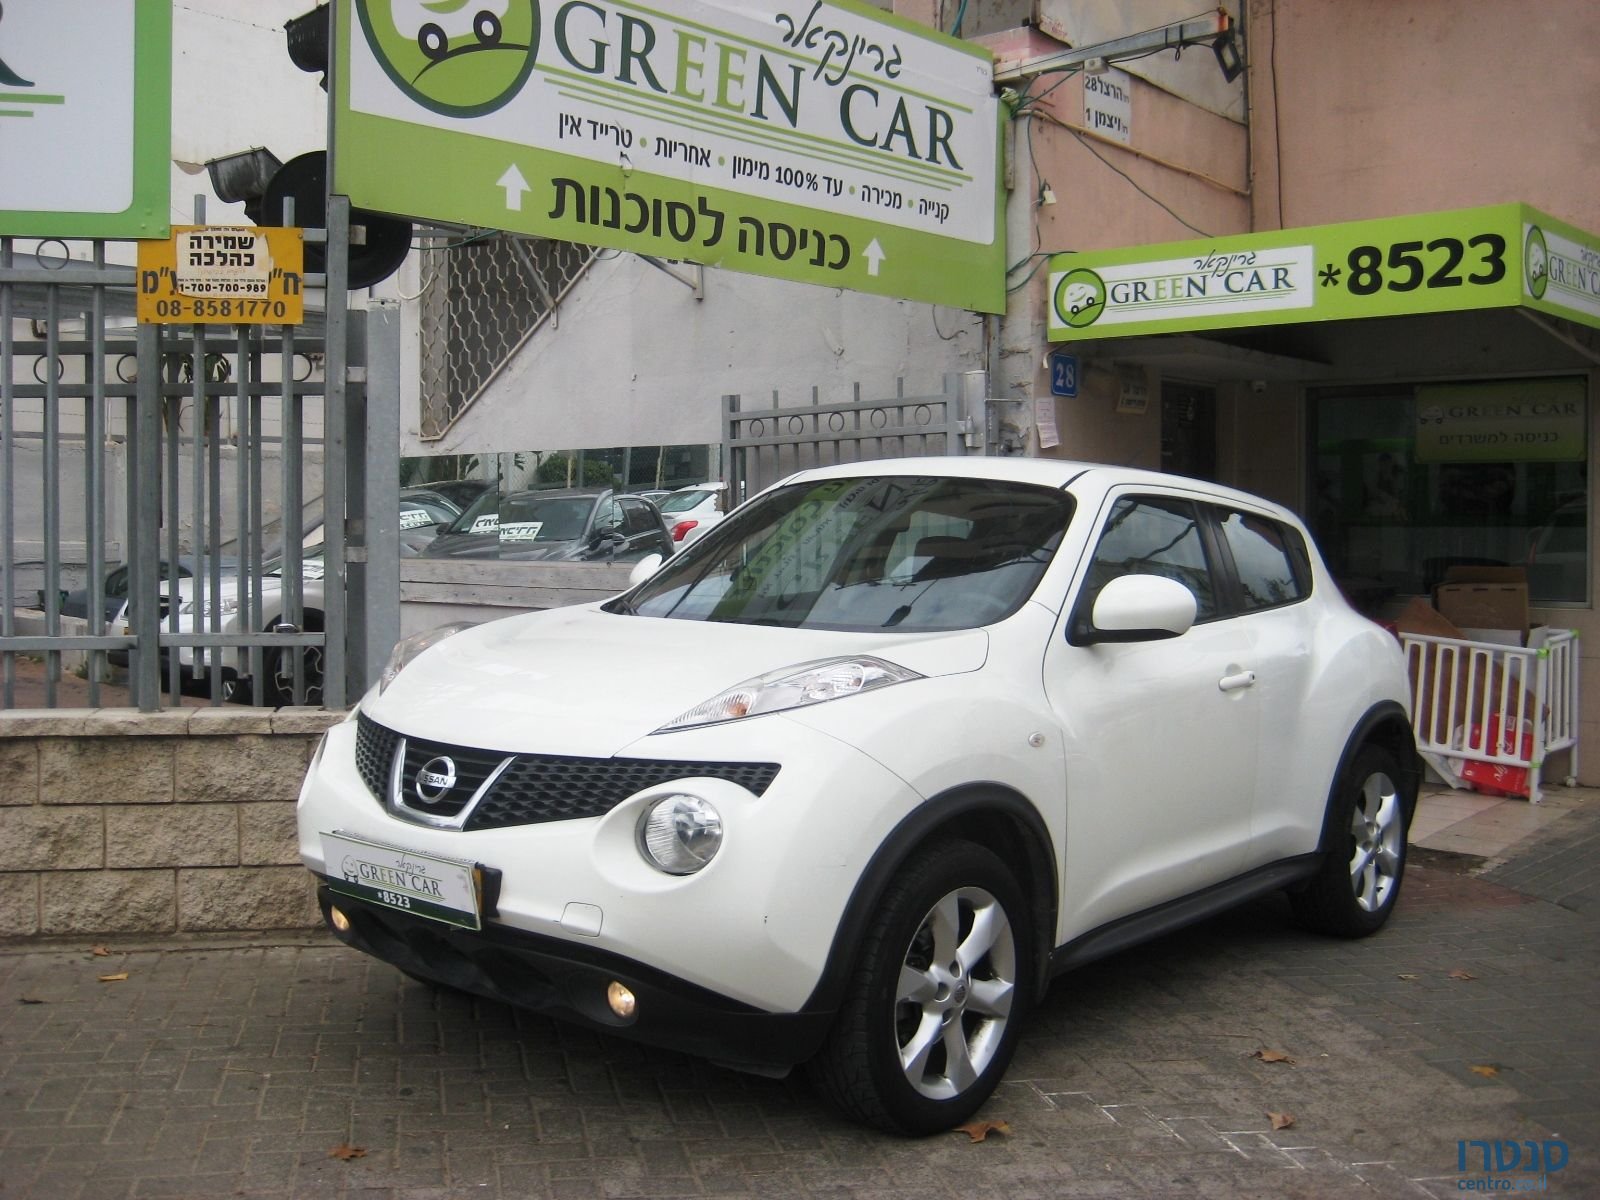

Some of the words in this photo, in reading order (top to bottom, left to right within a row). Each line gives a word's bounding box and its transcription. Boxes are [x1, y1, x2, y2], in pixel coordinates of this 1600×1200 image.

[776, 0, 901, 86] גרינקאר
[554, 1, 806, 128] GREEN
[840, 84, 964, 170] CAR
[559, 113, 582, 139] אין
[1085, 108, 1091, 121] 1
[1095, 110, 1121, 131] ויצמן
[587, 120, 633, 148] טרייד
[655, 137, 711, 168] אחריות
[732, 156, 770, 180] מימון
[775, 167, 819, 191] 100%
[823, 176, 844, 197] עד
[861, 185, 902, 209] מכירה
[548, 178, 725, 247] לסוכנות
[919, 198, 950, 224] קנייה
[190, 235, 255, 250] שמירה
[738, 217, 851, 270] כניסה
[190, 250, 255, 267] כהלכה
[1549, 256, 1587, 290] GREEN
[180, 283, 267, 293] 1-700-700-989
[1110, 274, 1208, 304] GREEN
[1224, 267, 1295, 294] CAR
[156, 299, 286, 318] 08-8581770
[1055, 362, 1074, 388] 28
[1532, 402, 1578, 416] CAR
[1439, 431, 1508, 446] למשרדים
[1514, 431, 1560, 444] כניסה
[359, 863, 406, 887] GREEN
[411, 876, 443, 897] CAR
